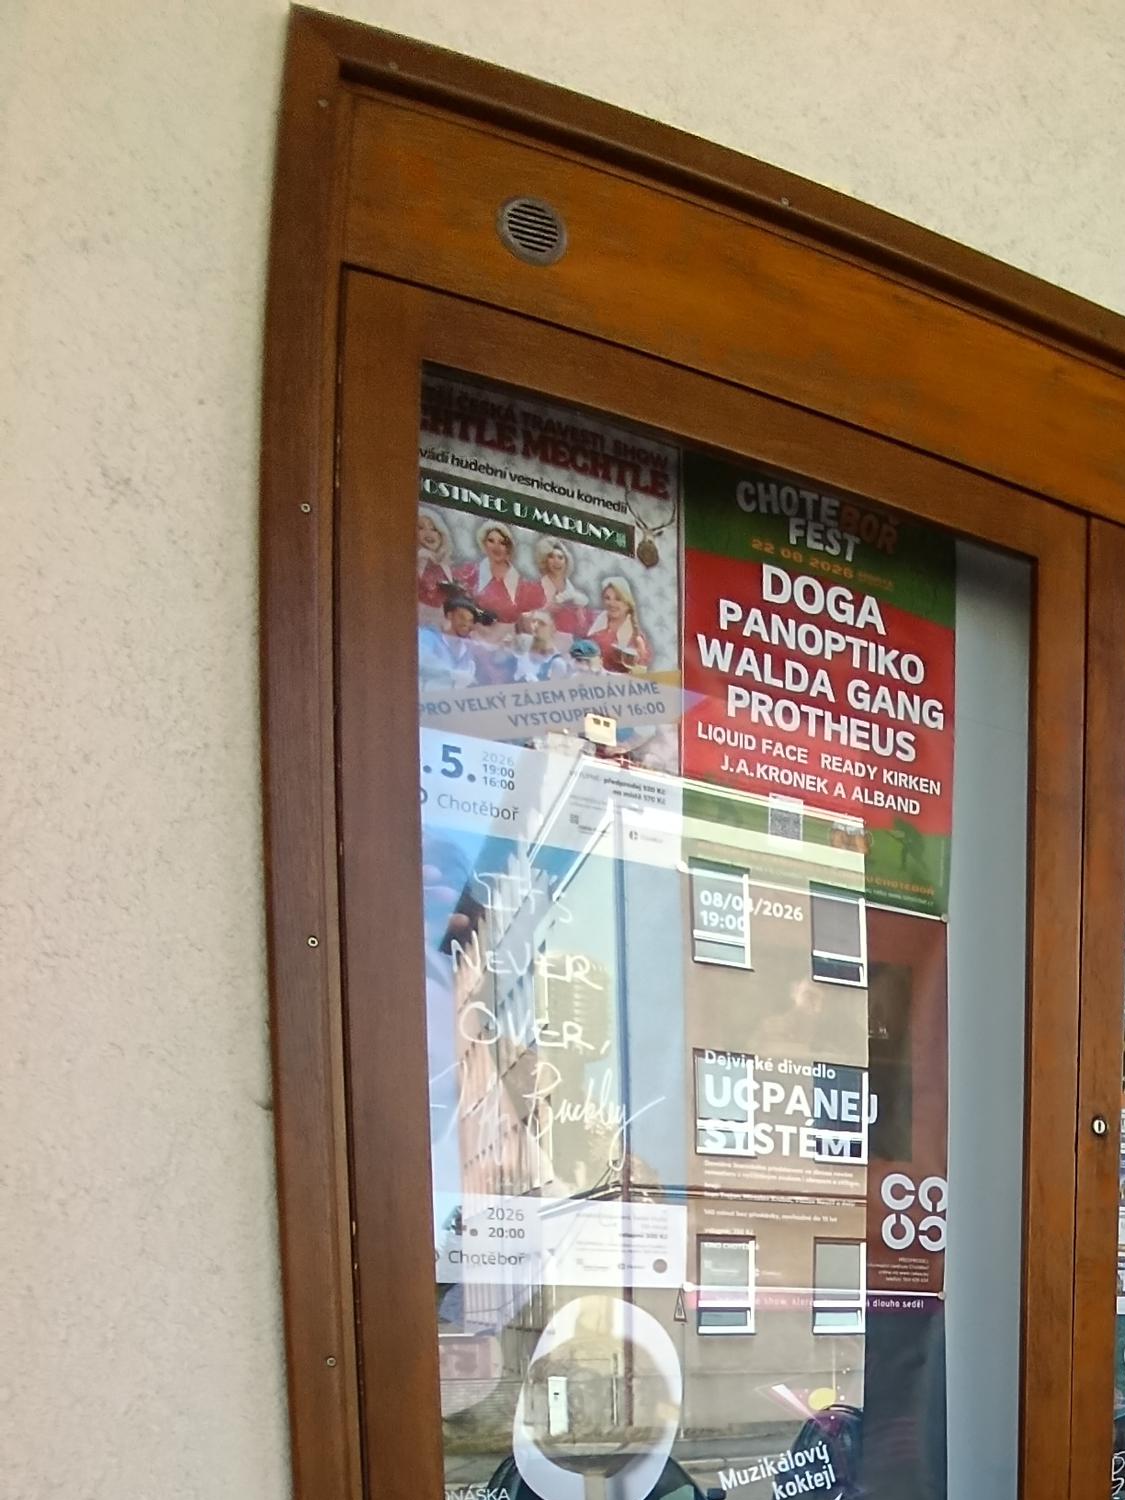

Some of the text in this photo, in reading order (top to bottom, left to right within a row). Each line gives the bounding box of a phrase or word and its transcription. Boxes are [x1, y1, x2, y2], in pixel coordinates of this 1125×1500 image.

[521, 430, 671, 500] MECHTLE
[509, 471, 575, 499] vesnickou
[513, 501, 530, 518] U
[789, 517, 862, 564] FEST
[761, 562, 888, 636] DOGA
[719, 598, 926, 686] PANOPTIKO
[455, 693, 507, 713] VELKÝ
[512, 686, 566, 707] ZÁJEM
[569, 679, 661, 705] PŘIDÁVÁME
[697, 633, 945, 731] WALDA GANG
[612, 705, 625, 719] V
[627, 701, 666, 718] 16:00
[727, 684, 918, 763] PROTHEUS
[482, 751, 514, 767] 2026
[482, 763, 515, 779] 19:00
[697, 720, 942, 797] LIQUID FACE READY KIRKEN
[482, 776, 515, 792] 16:00
[833, 781, 847, 799] A
[851, 784, 921, 816] ALBAND
[437, 793, 520, 822] Chotěboř
[451, 930, 605, 993] NEVER
[703, 1049, 837, 1081] Dejvické divadlo
[703, 1074, 879, 1125] UCPANEJ
[487, 1207, 525, 1222] 2026
[488, 1226, 526, 1240] 20:00
[448, 1249, 526, 1266] Chotěboř
[717, 1440, 832, 1492] Muzikálový
